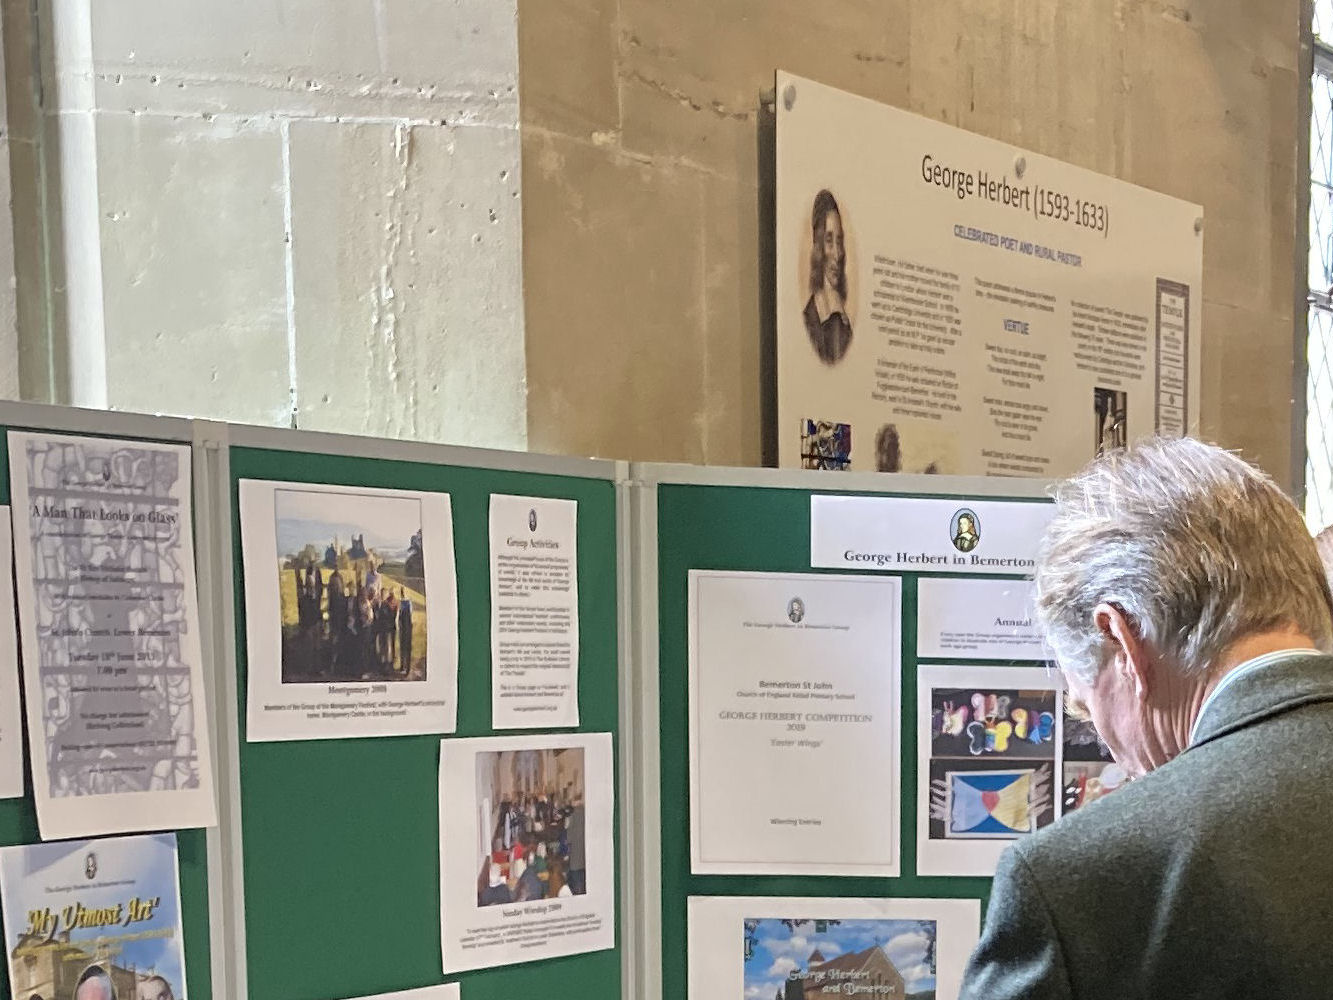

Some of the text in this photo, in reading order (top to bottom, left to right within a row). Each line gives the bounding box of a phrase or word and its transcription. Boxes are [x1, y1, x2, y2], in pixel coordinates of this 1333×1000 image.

[922, 154, 1109, 239] George Herbert (1593-1633)
[953, 224, 1082, 266] CELEBRATED POET AND RURAL PASTOR
[42, 505, 67, 519] Man
[71, 506, 96, 520] That
[100, 508, 130, 521] Looks
[132, 512, 146, 521] on
[843, 549, 1036, 567] George Herbert in Bemerton
[994, 618, 1032, 627] Annual
[759, 681, 833, 690] Bemerton St John
[719, 711, 872, 722] GEORGE HERBERT COMPETITION
[62, 902, 122, 932] Utmost
[123, 897, 160, 927] Art'
[790, 968, 870, 983] George Herbert
[822, 983, 842, 993] and
